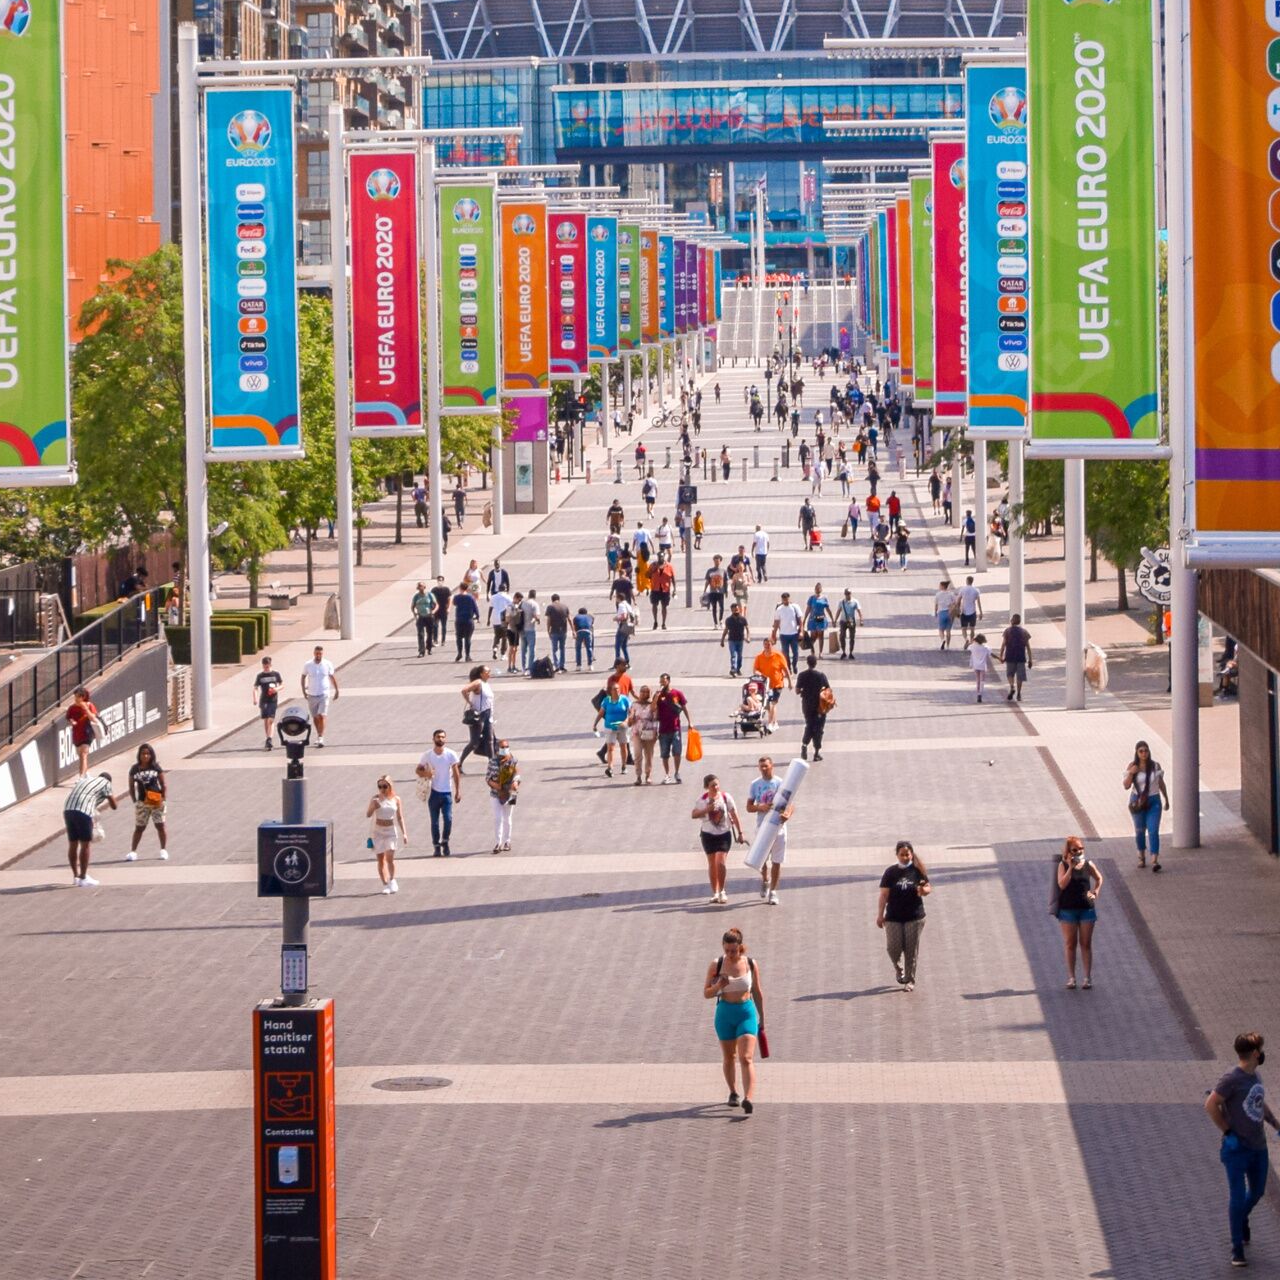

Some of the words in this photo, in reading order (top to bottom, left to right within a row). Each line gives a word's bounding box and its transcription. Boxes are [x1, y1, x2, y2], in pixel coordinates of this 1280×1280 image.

[1075, 40, 1106, 138] 2020
[987, 135, 1026, 144] EURO20
[1078, 145, 1108, 251] EURO
[376, 217, 394, 269] 2020
[519, 247, 530, 282] 2020
[595, 250, 605, 277] 2020
[377, 271, 395, 328] EURO
[519, 284, 531, 323] EURO
[596, 278, 605, 308] EURO
[1080, 258, 1110, 361] UEFA
[596, 309, 605, 337] UEFA
[378, 331, 396, 386] UEFA
[520, 324, 532, 362] UEFA
[264, 1020, 293, 1030] Hand
[264, 1032, 312, 1042] sanitiser
[264, 1044, 306, 1054] station
[265, 1128, 314, 1136] Contactless
